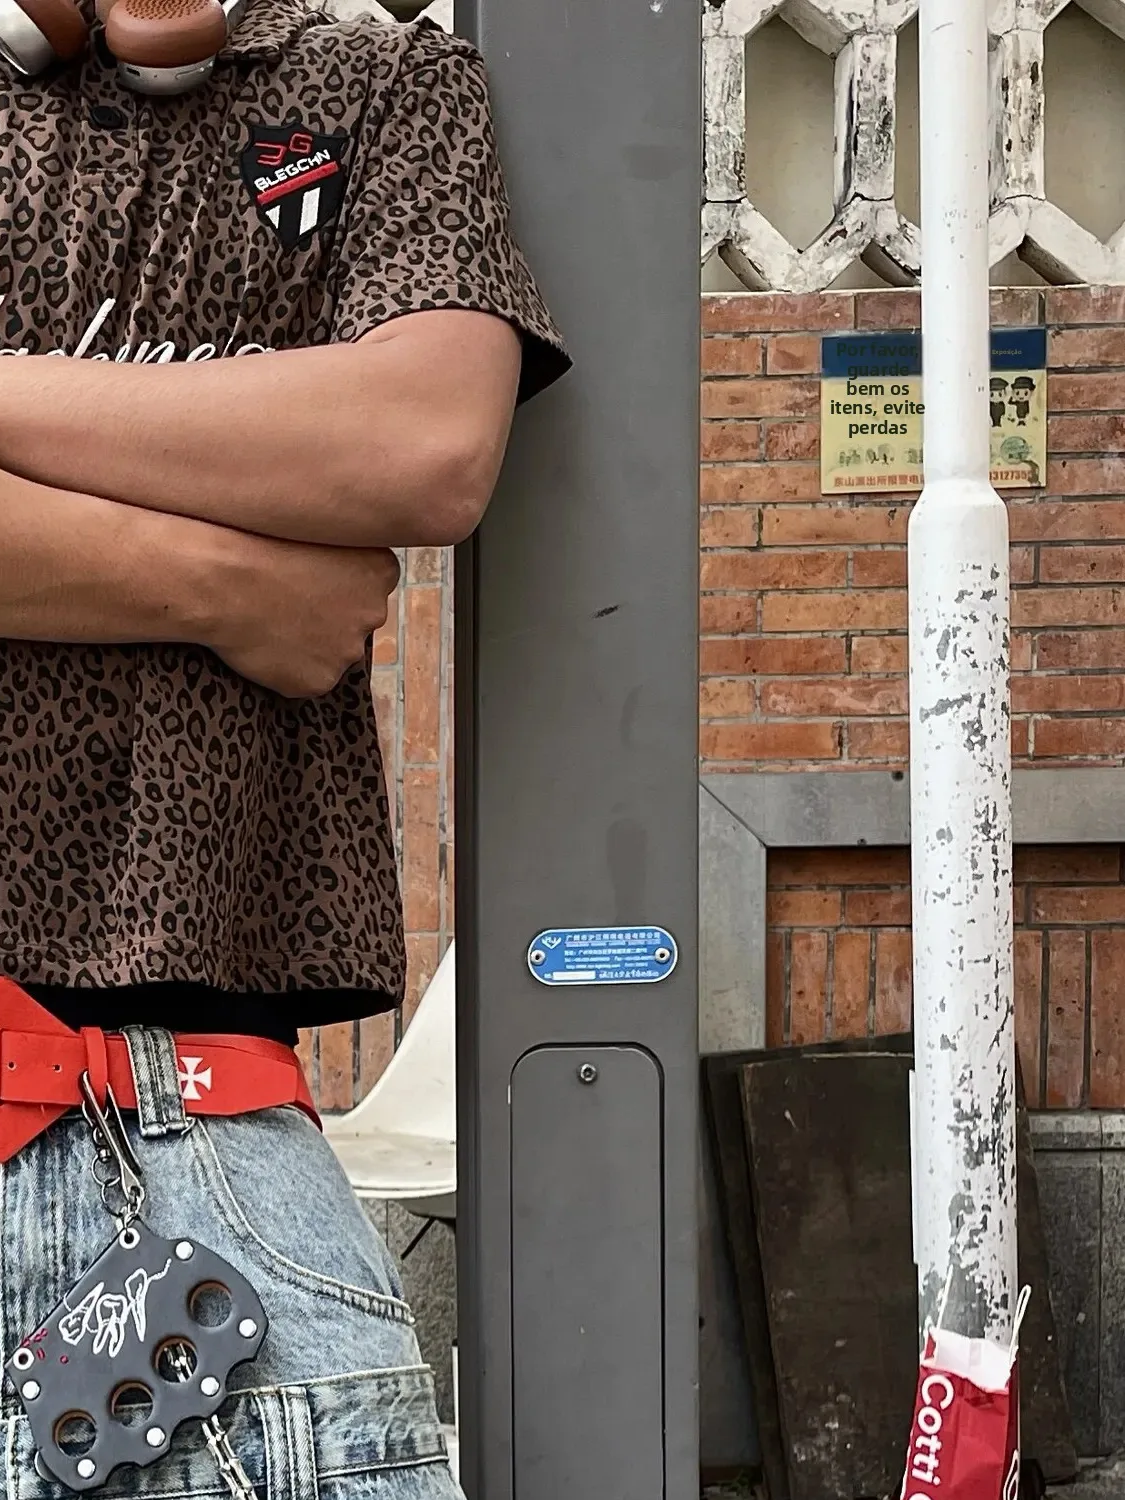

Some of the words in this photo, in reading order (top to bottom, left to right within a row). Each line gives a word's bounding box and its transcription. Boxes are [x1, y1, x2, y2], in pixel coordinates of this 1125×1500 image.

[254, 149, 331, 191] BLEGCHN
[834, 474, 924, 487] 东山派出所报警电
[911, 1373, 955, 1487] Cotti
